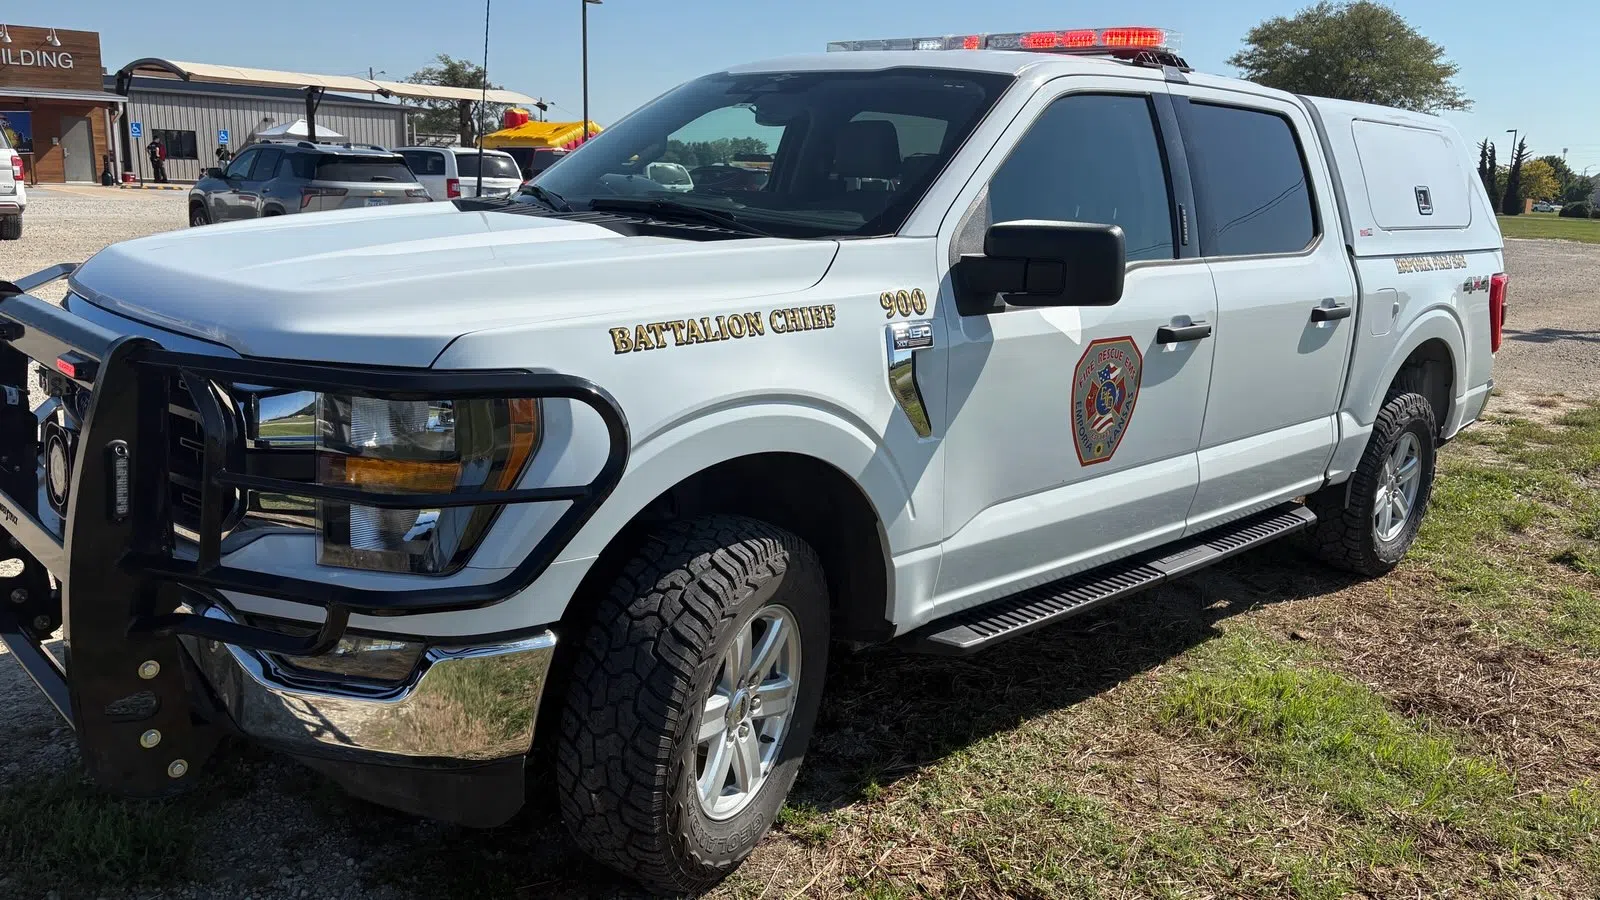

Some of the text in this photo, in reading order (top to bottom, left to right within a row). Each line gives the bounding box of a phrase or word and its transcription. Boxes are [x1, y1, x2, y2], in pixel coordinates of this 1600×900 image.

[1, 48, 74, 69] ILDING
[880, 288, 927, 319] 900
[609, 304, 836, 355] BATTALION CHIEF
[895, 326, 932, 339] F-150
[896, 340, 909, 348] XLT
[1079, 348, 1136, 388] FIRE RESCUE EMS
[1075, 391, 1134, 453] EMPORIA KANSAS
